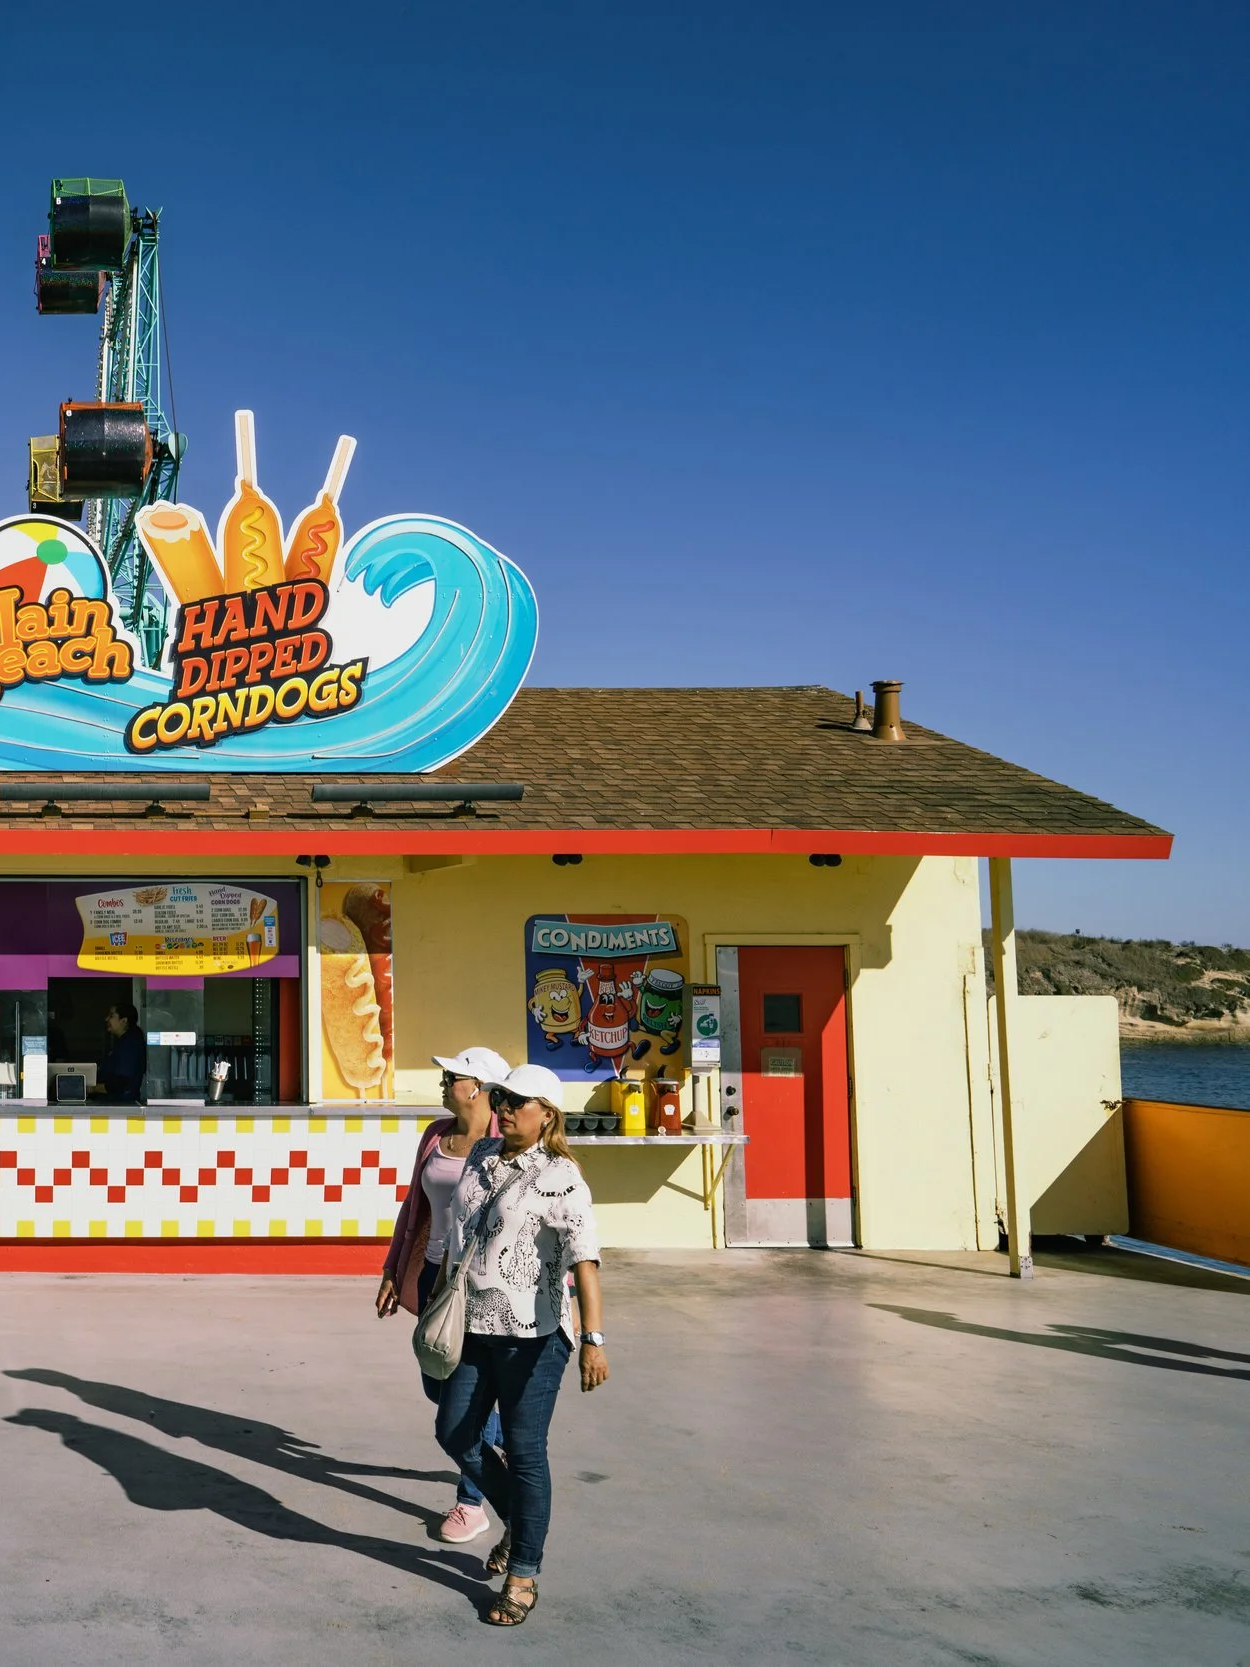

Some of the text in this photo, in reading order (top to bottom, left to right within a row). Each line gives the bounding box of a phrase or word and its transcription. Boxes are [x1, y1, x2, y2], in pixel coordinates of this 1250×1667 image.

[41, 257, 47, 265] 4
[177, 582, 325, 652] HAND
[176, 632, 328, 698] DIPPED
[131, 662, 363, 749] CORNDOGS
[536, 927, 671, 951] CONDIMENTS
[694, 987, 720, 995] NAPKINS
[589, 1027, 627, 1044] KETCHUP
